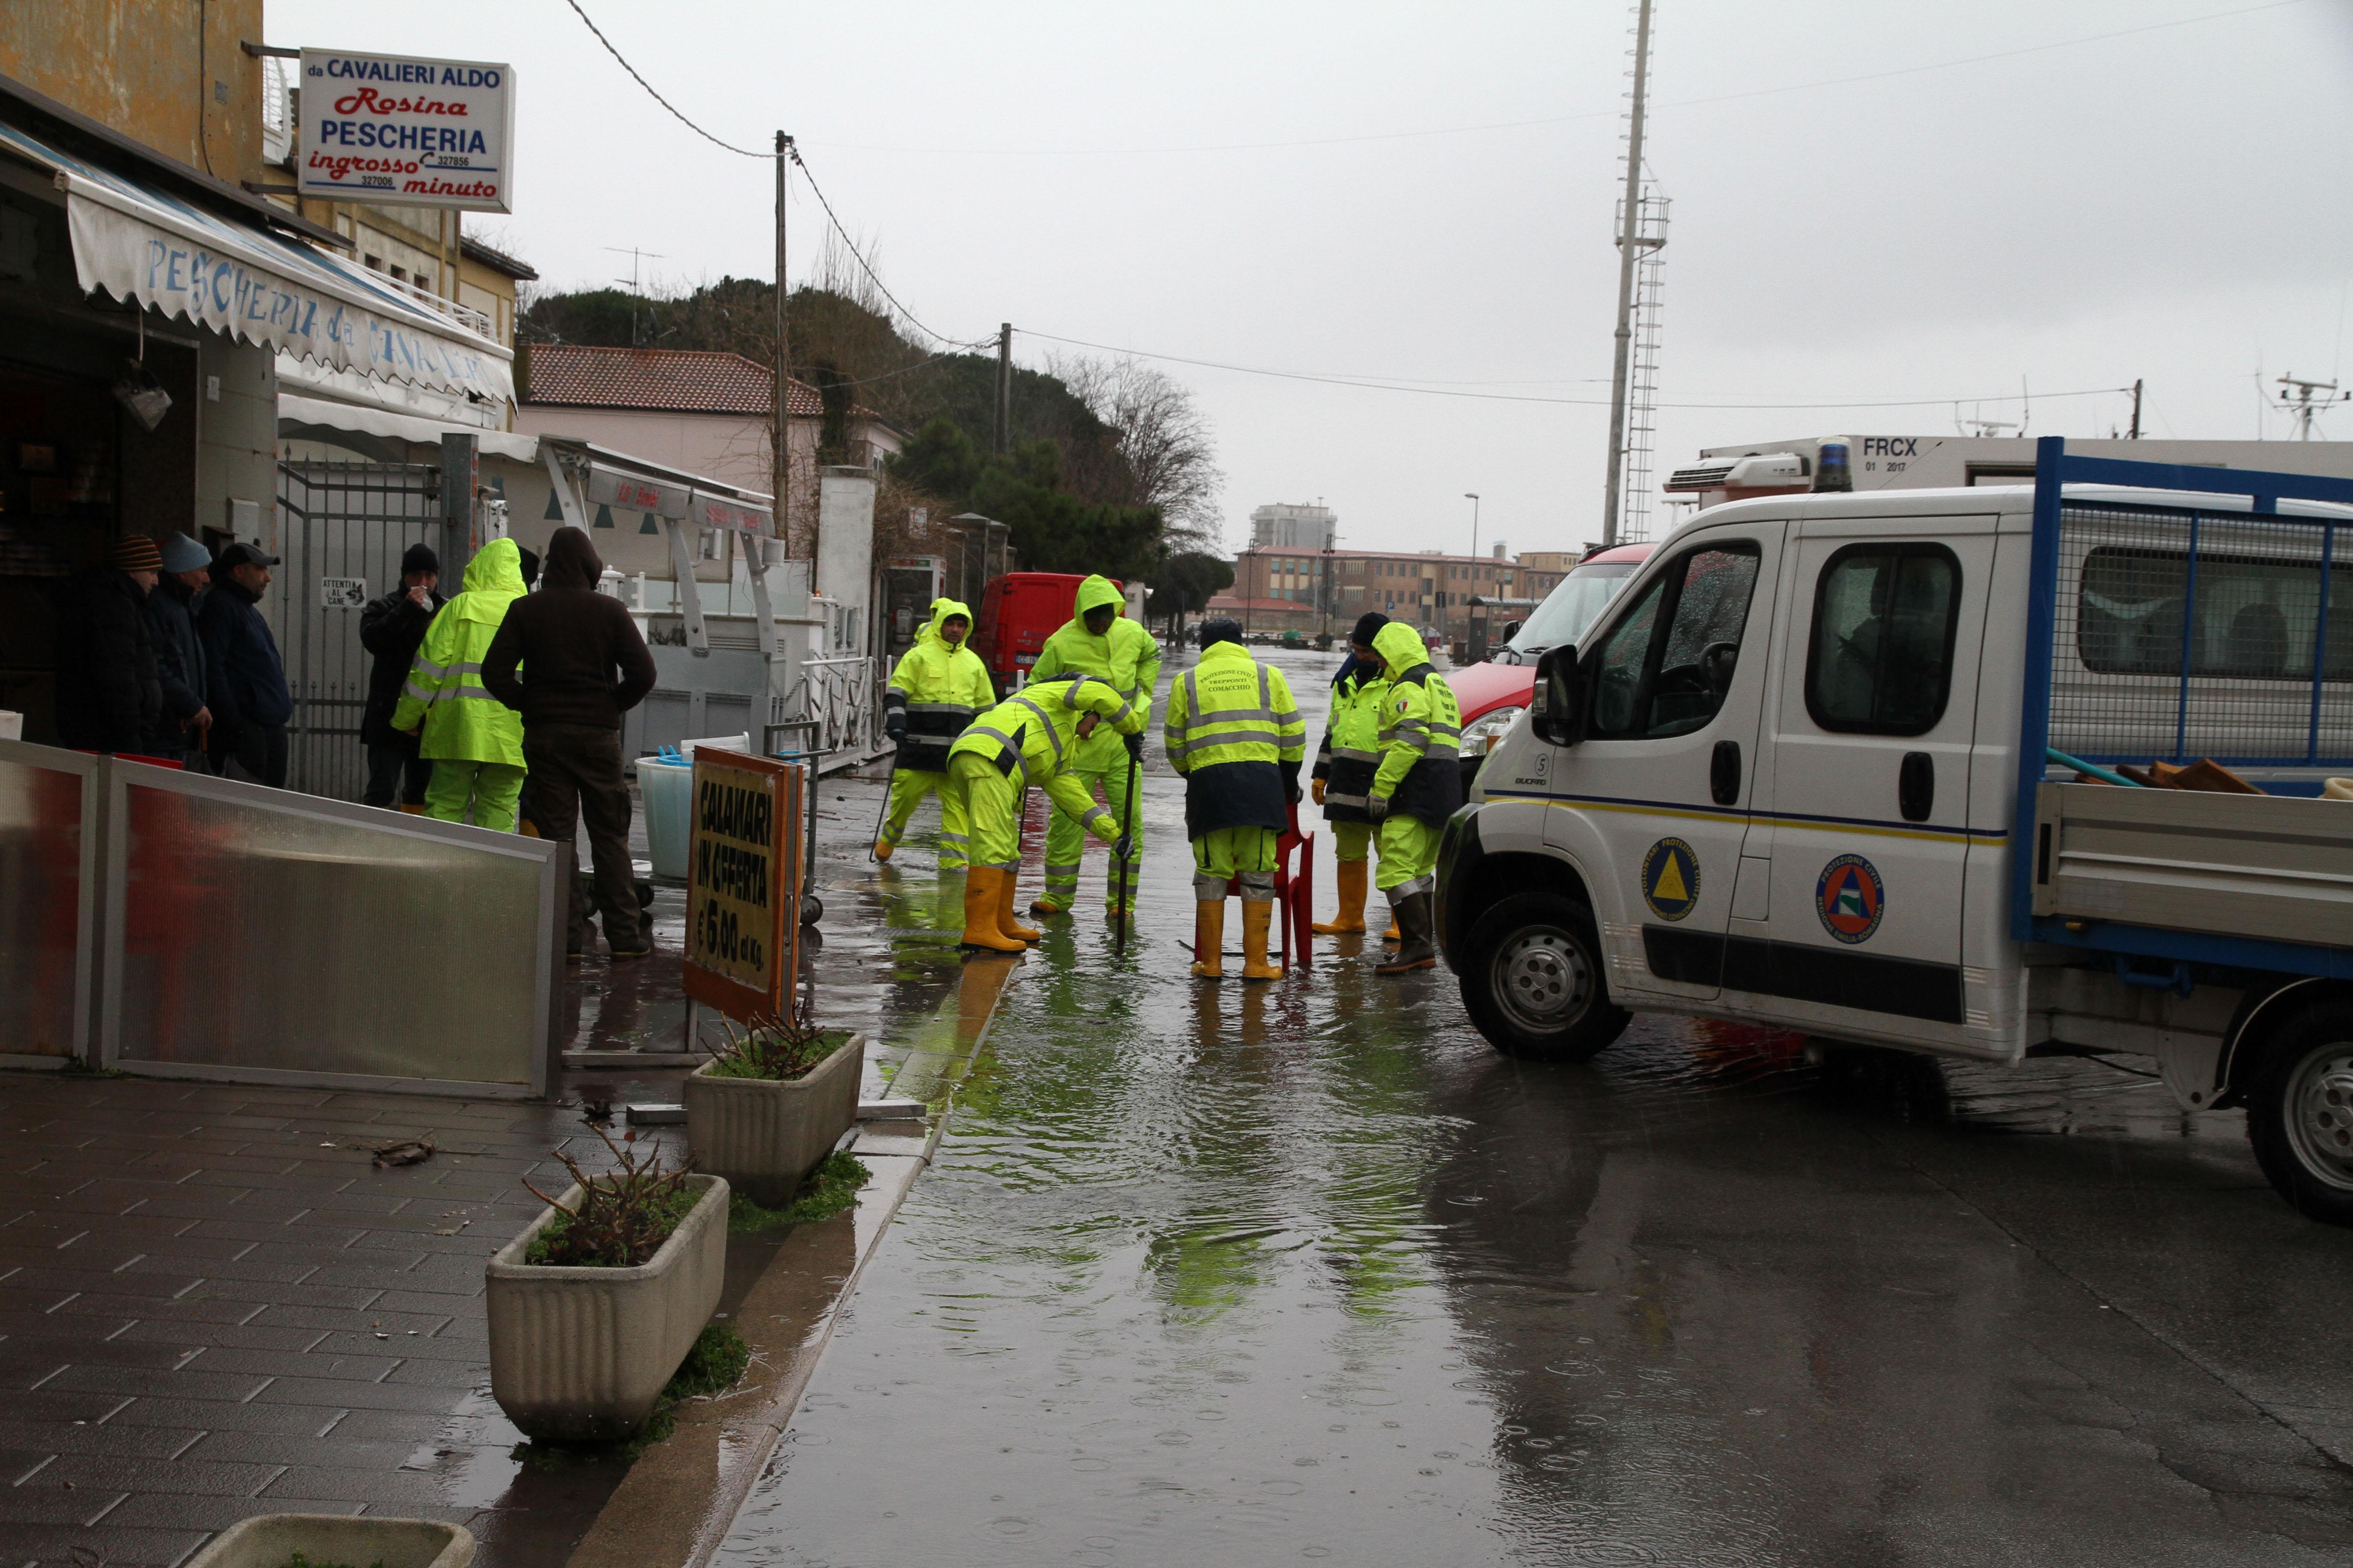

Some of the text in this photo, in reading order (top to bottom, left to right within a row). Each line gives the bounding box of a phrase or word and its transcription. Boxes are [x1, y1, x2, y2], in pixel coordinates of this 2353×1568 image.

[308, 59, 500, 88] da CAVALIERI ALDO
[334, 87, 468, 115] Rosina
[321, 119, 487, 154] PESCHERIA
[308, 151, 419, 180] ingrosso
[438, 156, 469, 166] 327856
[361, 175, 393, 186] 327006
[403, 177, 496, 197] minuto
[147, 239, 321, 340] PESCHERIA
[1864, 438, 1917, 456] FRCX
[1866, 462, 1906, 472] 01 2017
[332, 589, 341, 597] AL
[1200, 670, 1256, 683] PROTEZIONE CIVILE
[1538, 758, 1546, 771] 5
[1515, 777, 1546, 786] DUCATO
[701, 780, 772, 848] CALAMARI
[698, 838, 767, 909] IN OFFERTA
[1641, 845, 1659, 894] VOLONTARI
[1662, 838, 1698, 867] PROTEZIONE
[1820, 856, 1881, 889] PROTEZIONE CIVILE
[1817, 896, 1835, 931] REGIONE
[698, 909, 704, 947] €
